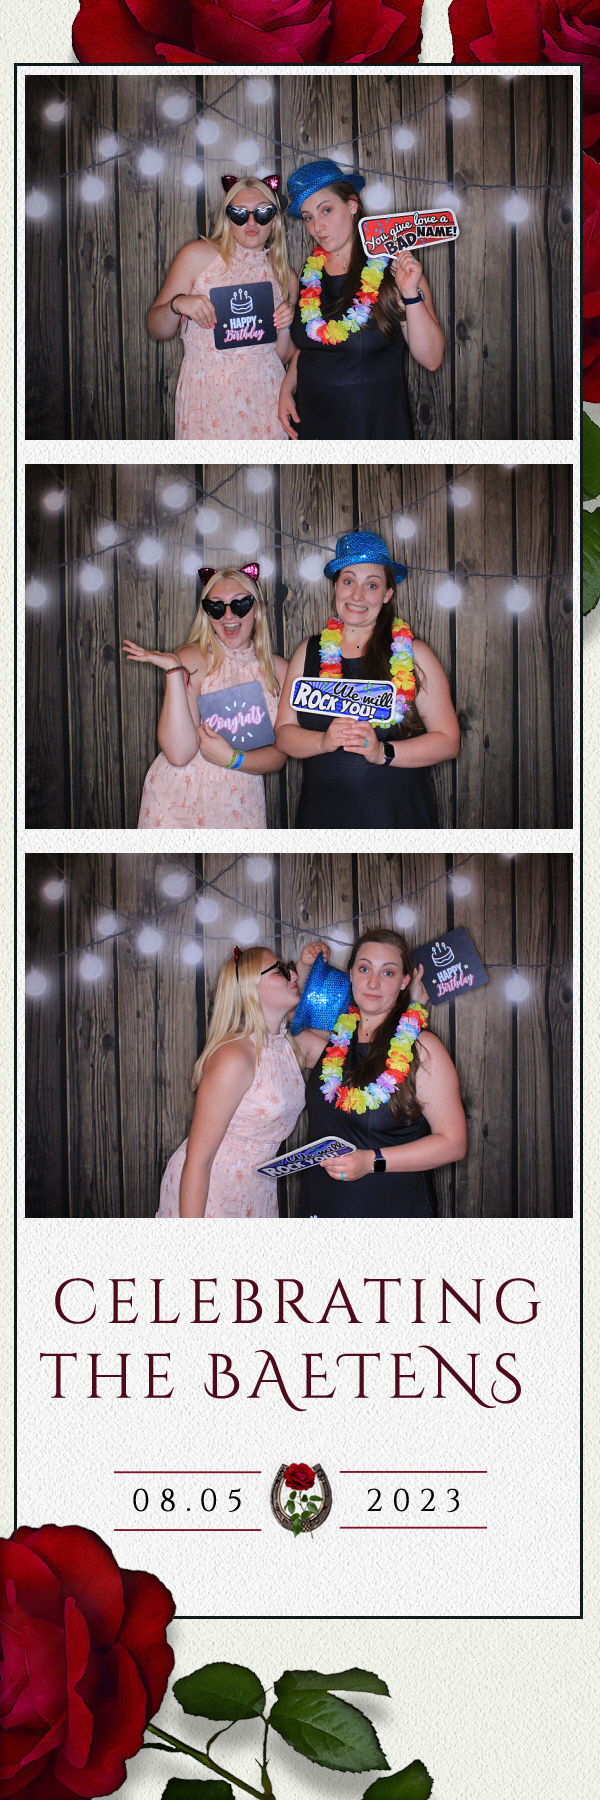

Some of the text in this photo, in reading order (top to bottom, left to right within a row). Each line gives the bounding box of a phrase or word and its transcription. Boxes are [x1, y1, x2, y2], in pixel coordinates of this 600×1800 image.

[365, 212, 449, 251] You give love a
[384, 225, 458, 255] BAD NAME!
[223, 325, 265, 343] Birthday
[229, 315, 257, 330] HAPPY
[292, 681, 377, 718] ROCK YOU!
[333, 681, 394, 708] We will
[204, 705, 266, 735] Congrats
[436, 962, 463, 983] HAPPY
[436, 971, 475, 997] Birthday
[261, 1161, 306, 1177] ROCK
